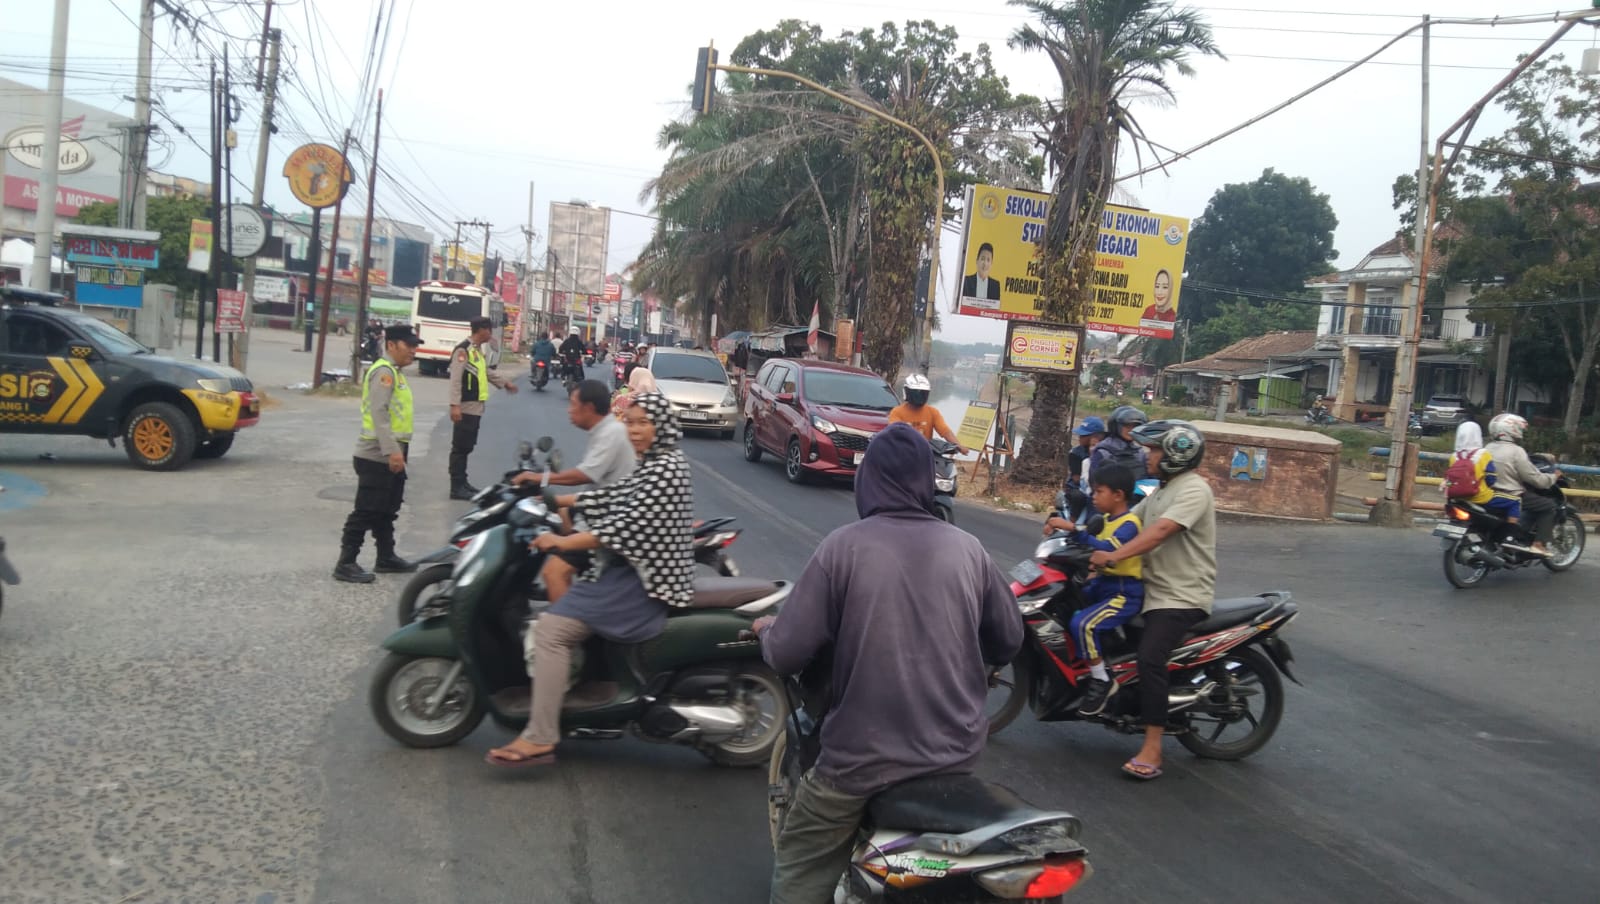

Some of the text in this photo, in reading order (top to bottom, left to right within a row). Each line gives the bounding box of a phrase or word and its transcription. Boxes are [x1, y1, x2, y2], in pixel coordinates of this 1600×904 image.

[19, 139, 79, 165] Amda
[22, 183, 104, 207] ASA MOT
[1116, 212, 1160, 236] EKONOMI
[1092, 270, 1128, 289] ISWA BARU
[1005, 277, 1038, 295] PROGRAM
[1097, 288, 1129, 307] MAGISTER
[1029, 345, 1059, 354] CORNER
[1030, 338, 1059, 348] ENGLISH
